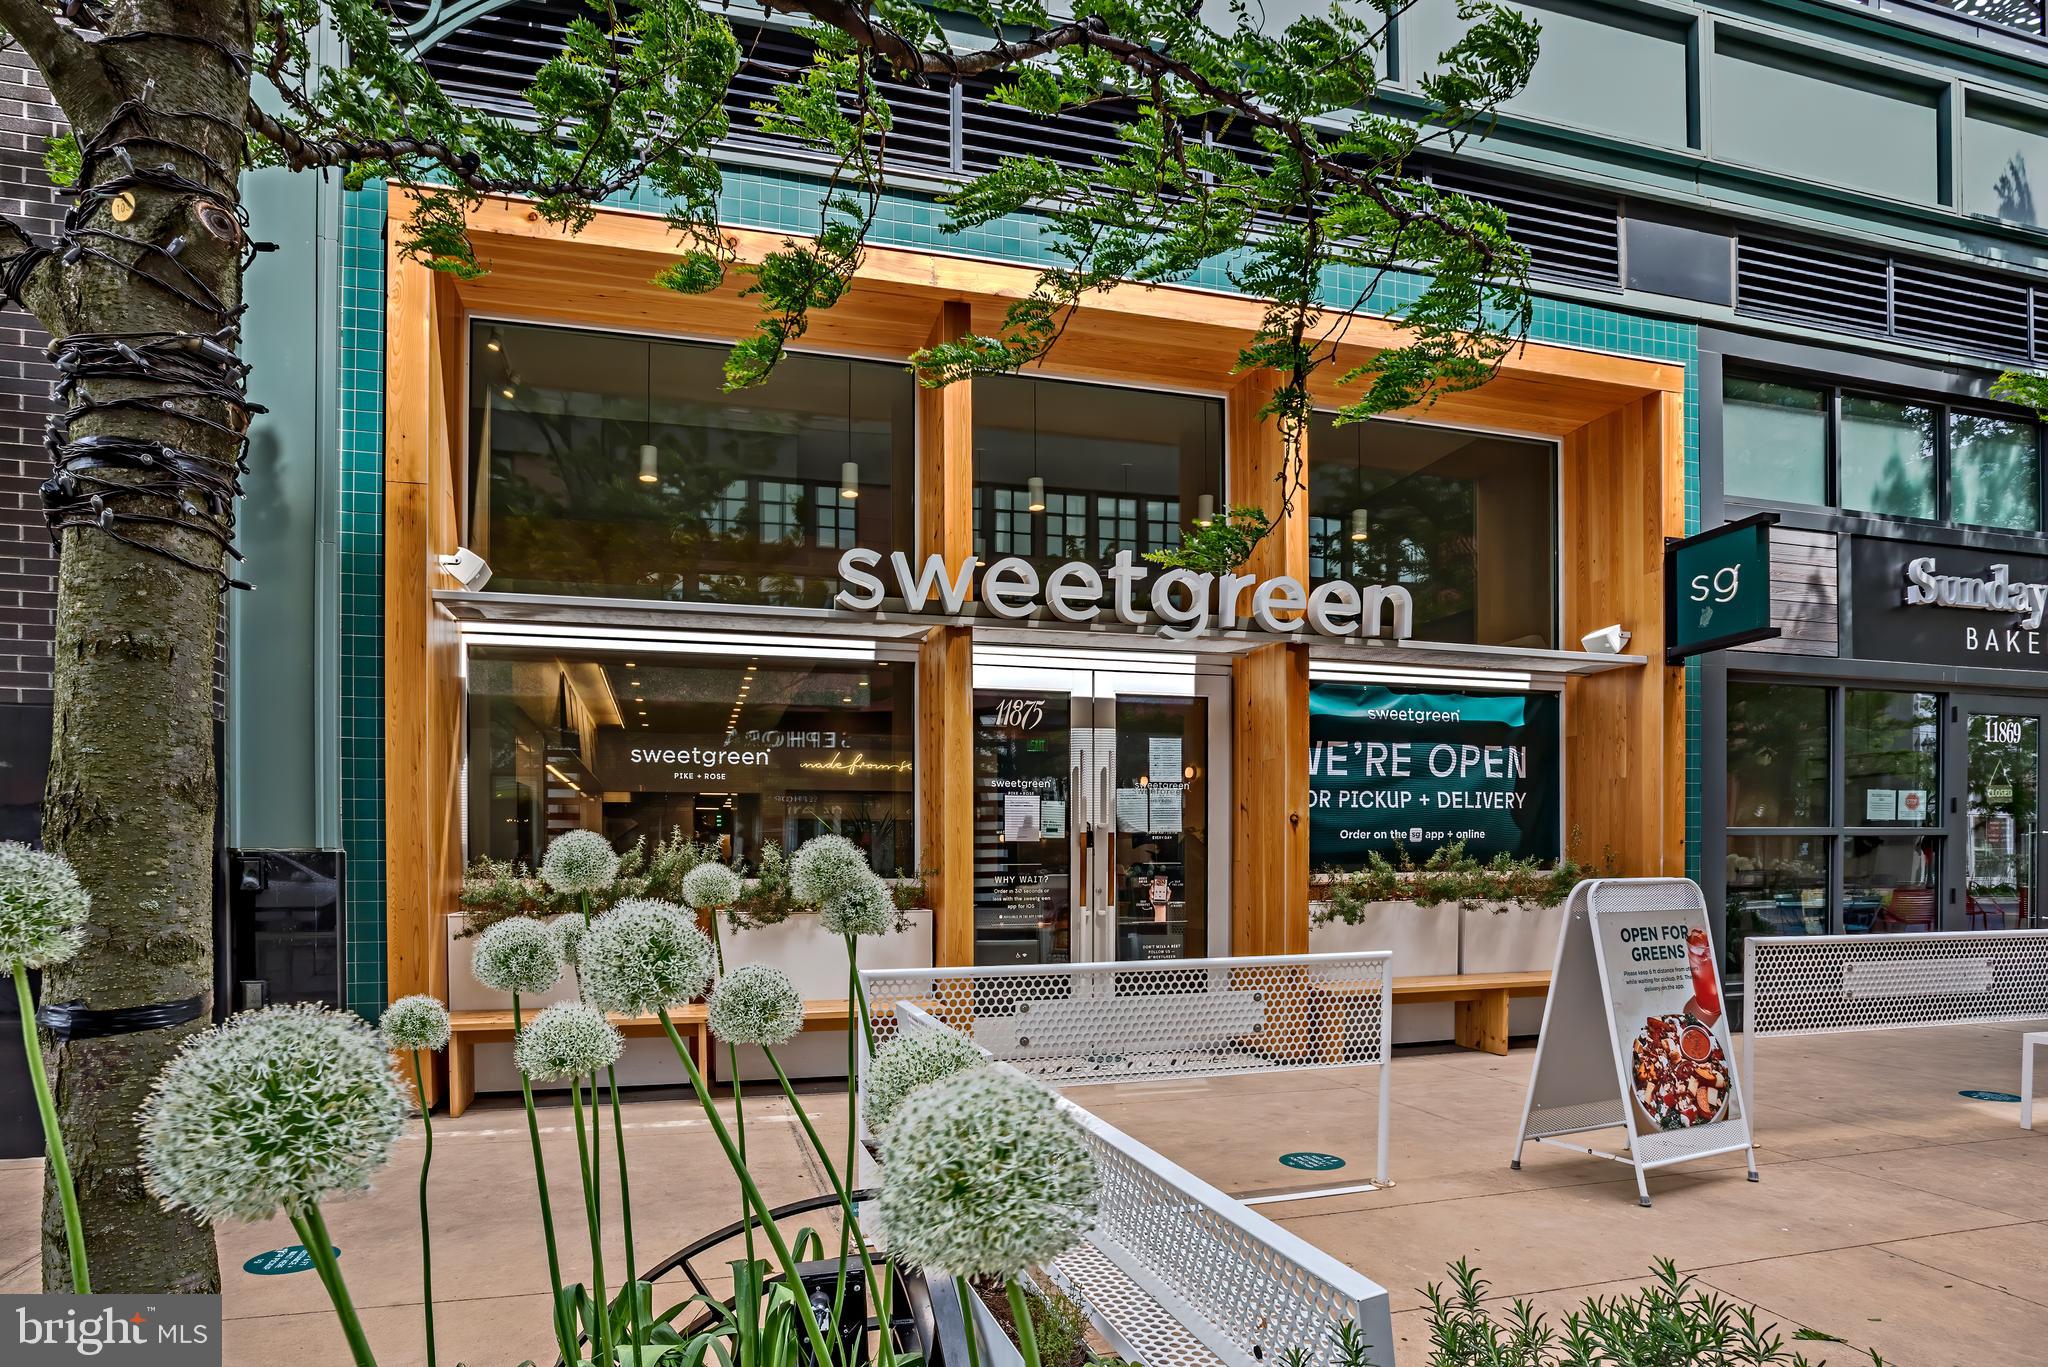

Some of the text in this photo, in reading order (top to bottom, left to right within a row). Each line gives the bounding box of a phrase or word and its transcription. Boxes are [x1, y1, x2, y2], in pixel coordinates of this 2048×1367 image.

[1690, 563, 1741, 602] sg
[837, 547, 1413, 641] sweetgreen
[1907, 557, 2048, 630] Sunday
[1966, 627, 2040, 654] BAKE
[995, 699, 1046, 730] 11875
[1367, 707, 1461, 724] sweetgreen
[1984, 721, 2022, 744] 11869
[630, 746, 771, 768] sweetgreen
[800, 752, 843, 769] made
[848, 753, 892, 775] from
[1428, 743, 1527, 779] OPEN
[673, 772, 694, 780] PIKE
[991, 778, 1052, 790] sweetgreen
[1338, 790, 1412, 809] PICKUP
[1419, 793, 1430, 807] +
[1437, 791, 1527, 809] DELIVERY
[1987, 788, 2013, 798] CLOSED
[1340, 829, 1371, 839] Order
[1373, 831, 1388, 839] on
[1390, 829, 1407, 839] the
[1425, 832, 1444, 841] app
[1456, 829, 1486, 839] online
[994, 875, 1049, 884] WHY WAIT?
[1620, 925, 1689, 943] OPEN FOR
[1631, 944, 1686, 962] GREENS
